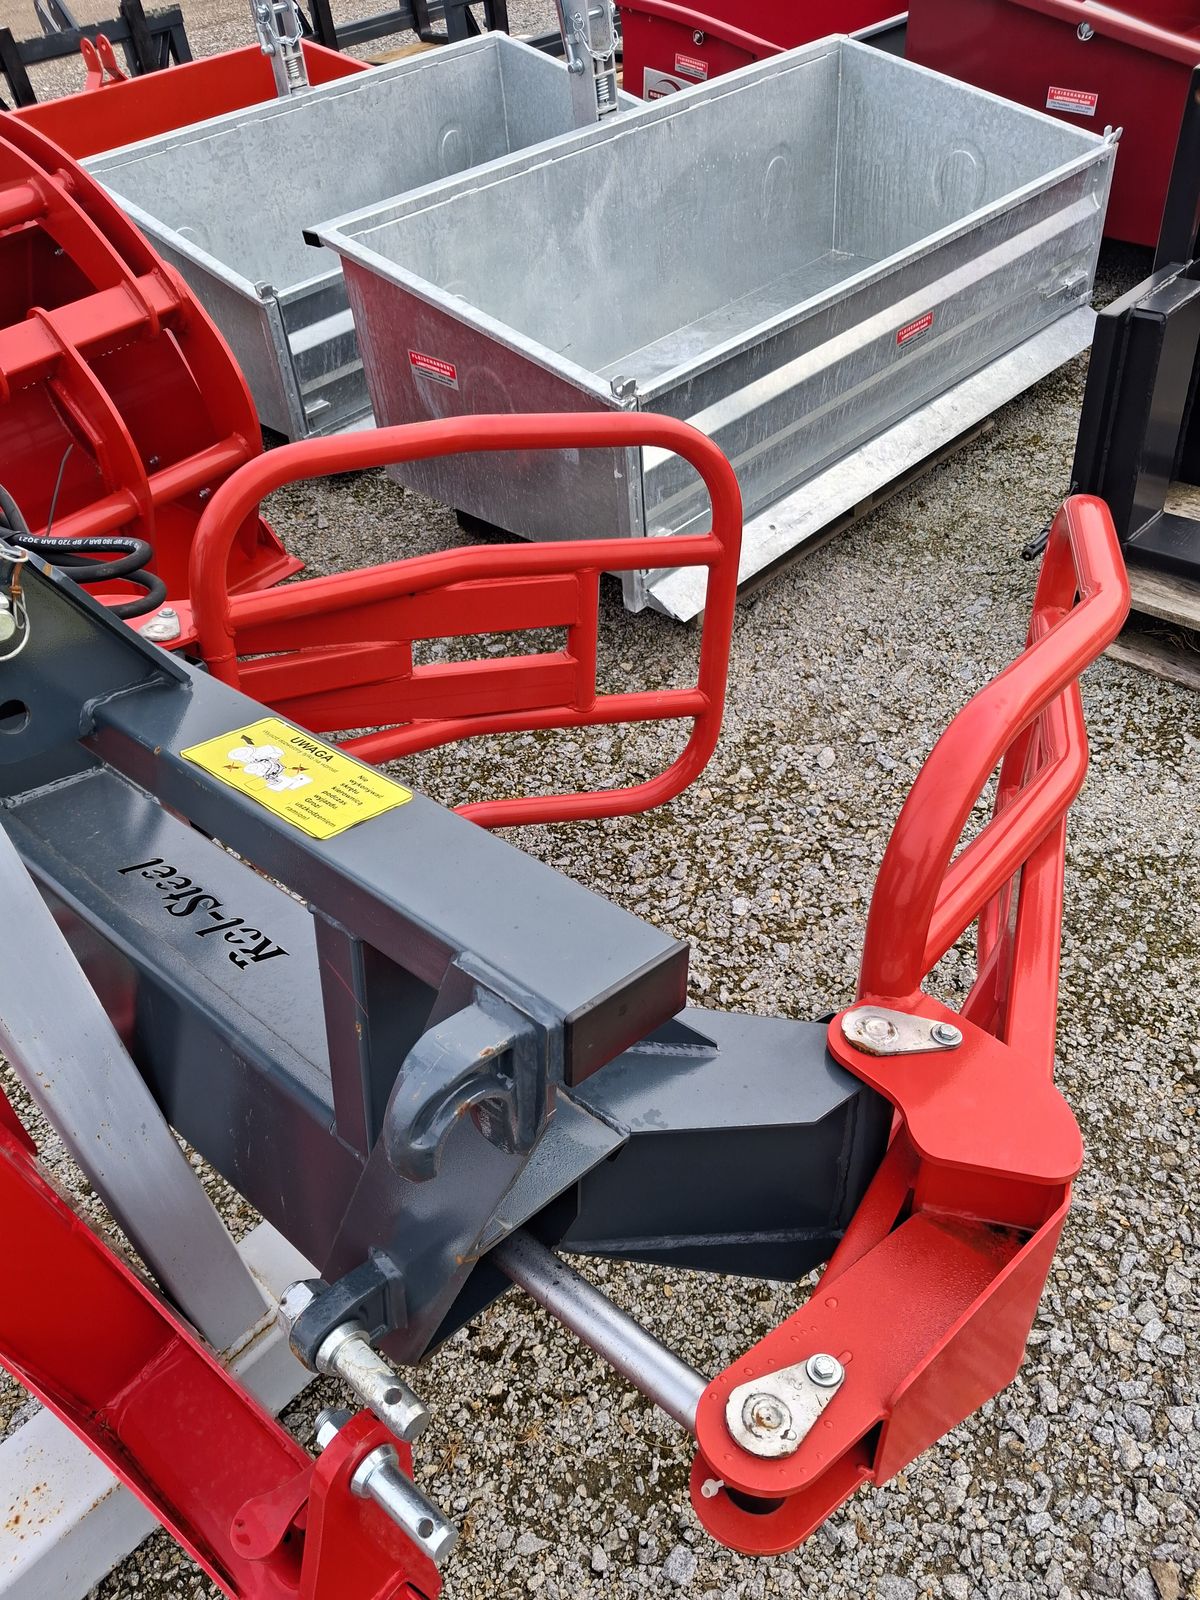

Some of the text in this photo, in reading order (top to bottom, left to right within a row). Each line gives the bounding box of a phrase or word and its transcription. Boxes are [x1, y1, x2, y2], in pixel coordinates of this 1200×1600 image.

[290, 736, 334, 762] UWAGA
[321, 790, 347, 806] podczas
[294, 801, 336, 828] uszkodzeniem
